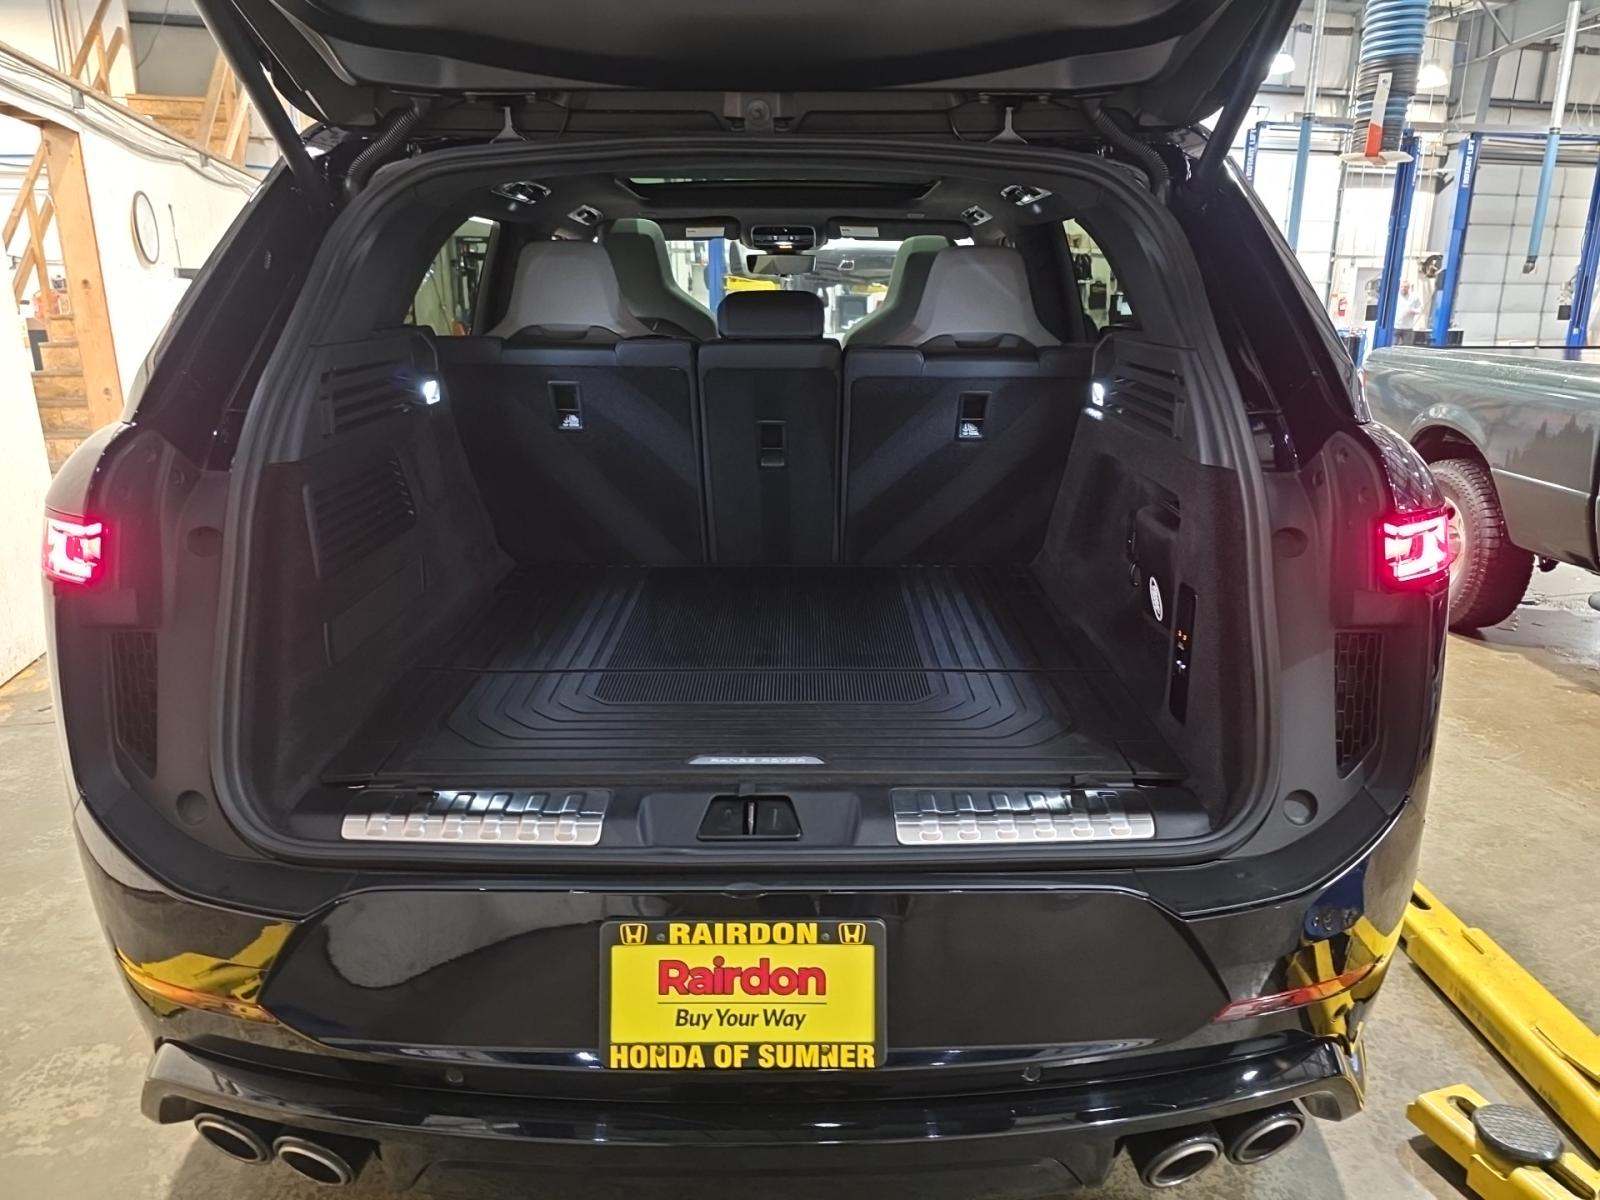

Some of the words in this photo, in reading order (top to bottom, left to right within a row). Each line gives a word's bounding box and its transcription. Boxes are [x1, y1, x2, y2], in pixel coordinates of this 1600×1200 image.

[1466, 139, 1476, 155] LIFT
[1462, 155, 1473, 184] ROTARY
[669, 922, 818, 945] RAIRDON
[658, 955, 827, 996] Rairdon
[675, 1008, 713, 1030] Buy
[715, 1008, 759, 1027] Your
[763, 1008, 807, 1030] Way
[609, 1044, 706, 1069] HONDA
[713, 1044, 749, 1069] OF
[758, 1043, 876, 1069] SUMNER
